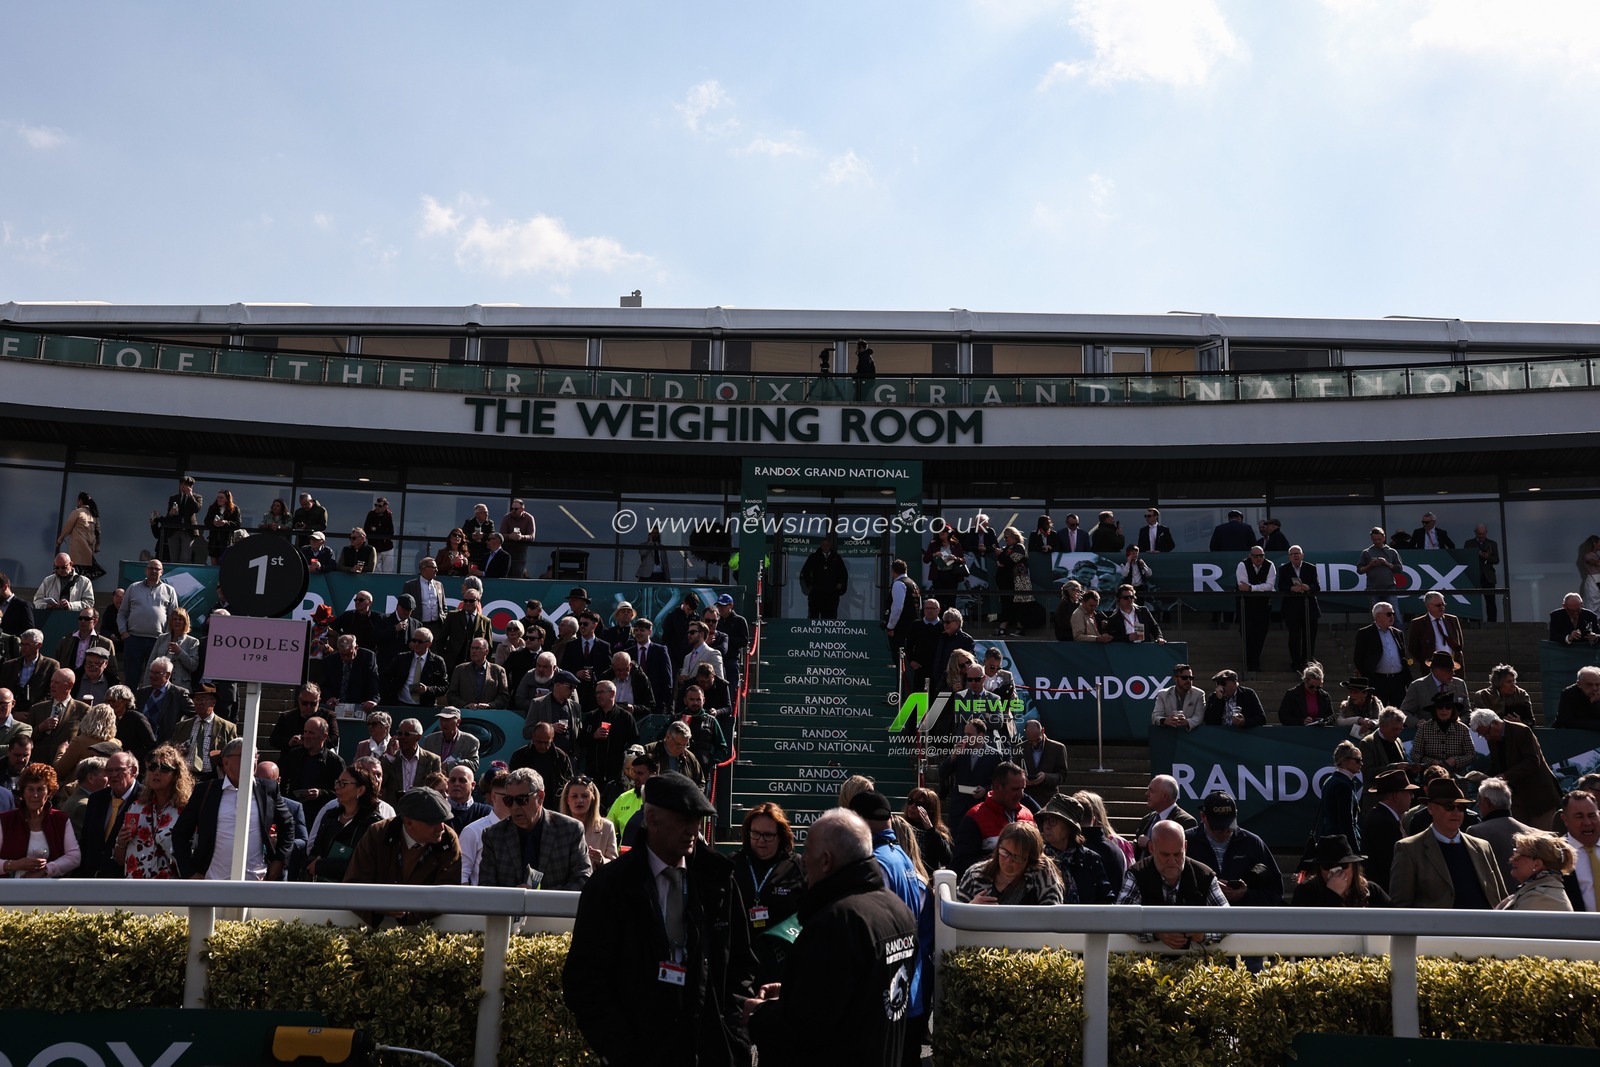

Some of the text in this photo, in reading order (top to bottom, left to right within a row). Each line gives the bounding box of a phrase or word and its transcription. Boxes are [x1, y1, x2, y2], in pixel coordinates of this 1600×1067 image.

[505, 373, 791, 401] RANDOX
[874, 383, 1111, 404] GRAND
[464, 397, 983, 444] THE WEIGHING ROOM
[754, 466, 910, 479] RANDOX GRAND NATIONAL
[248, 554, 284, 595] 1st
[824, 627, 868, 636] NATIONAL
[213, 634, 300, 652] BOODLES
[809, 641, 847, 650] RANDOX
[242, 653, 268, 662] 1798
[787, 650, 869, 659] GRAND NATIONAL
[806, 667, 847, 676] RANDOX
[784, 676, 871, 686] GRAND NATIONAL
[1035, 675, 1172, 700] RANDOX
[805, 695, 848, 705] RANDOX
[779, 706, 873, 717] GRAND NATIONAL
[801, 728, 848, 739] RANDOX
[774, 741, 875, 753] GRAND NATIONAL
[798, 768, 848, 779] RANDOX
[768, 782, 812, 792] GRAND
[1171, 763, 1363, 801] RAND
[885, 935, 915, 956] RANDOX
